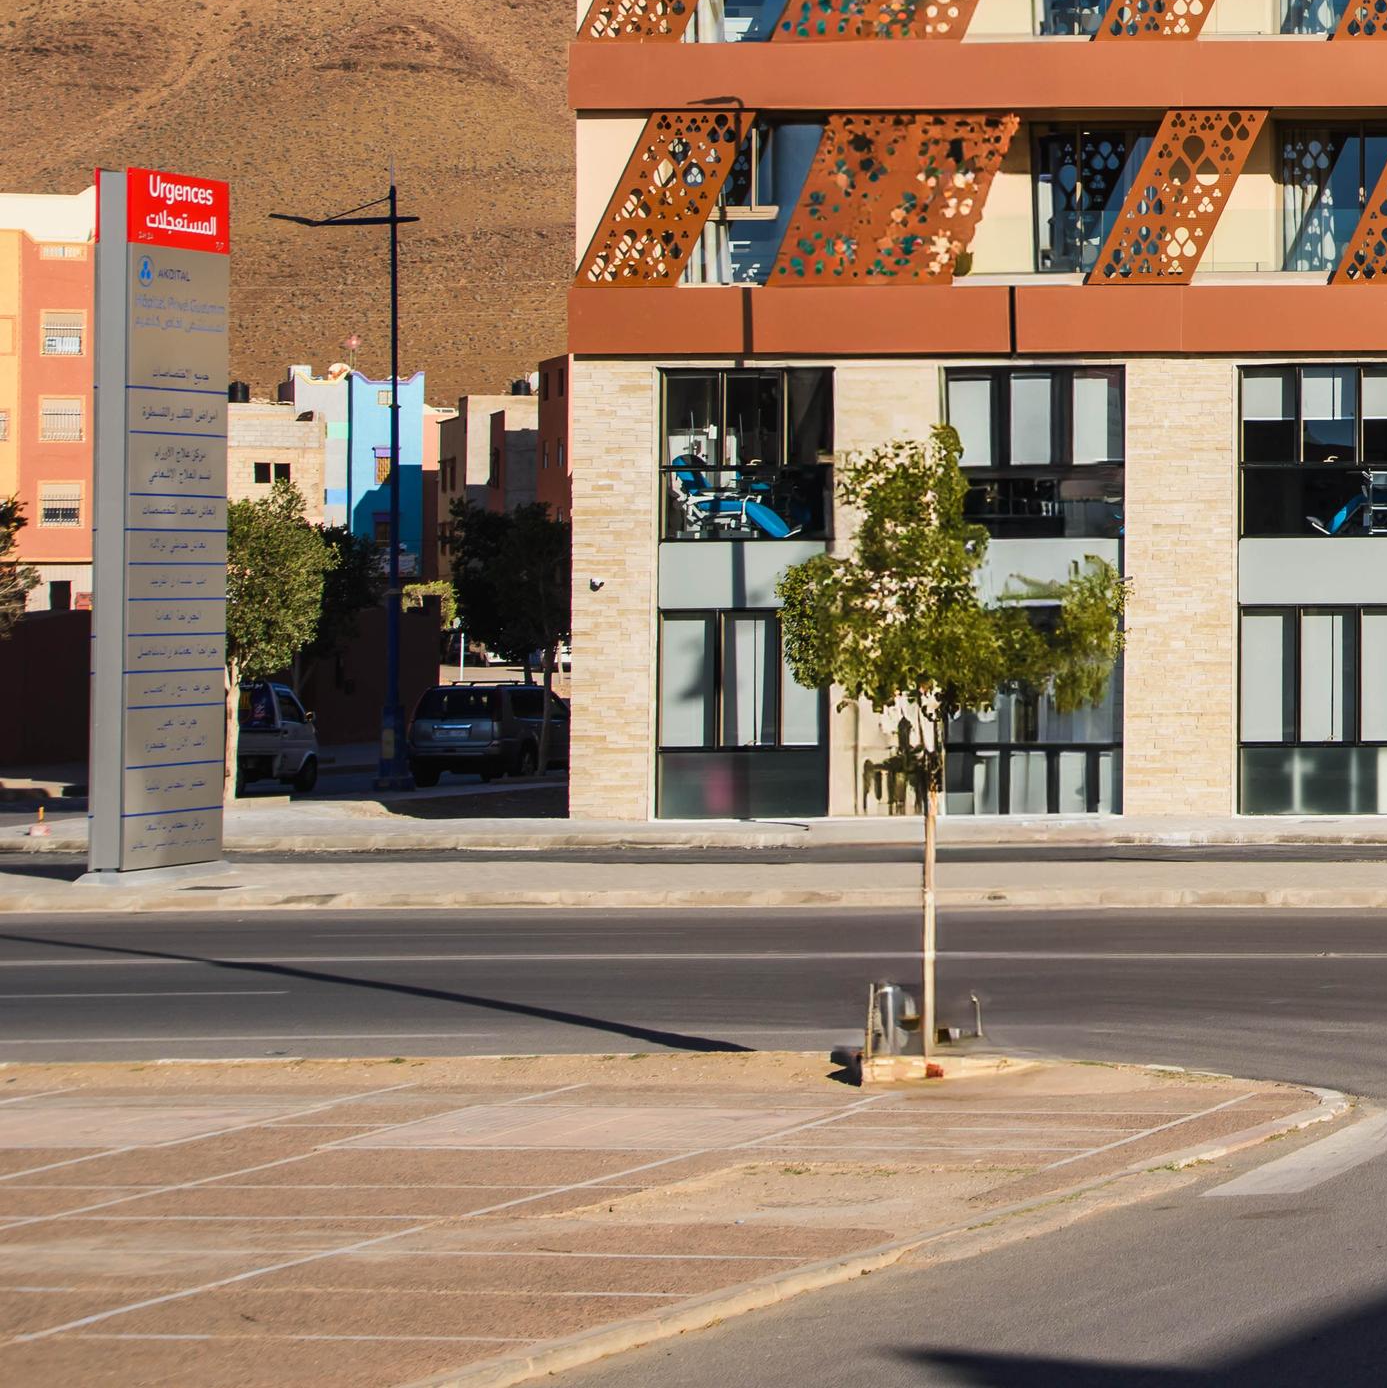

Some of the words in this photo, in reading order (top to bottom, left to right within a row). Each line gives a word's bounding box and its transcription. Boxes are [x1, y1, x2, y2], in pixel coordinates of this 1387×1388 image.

[149, 174, 213, 205] Urgences
[146, 209, 217, 236] المستعجلات
[158, 268, 191, 283] AKDITAL
